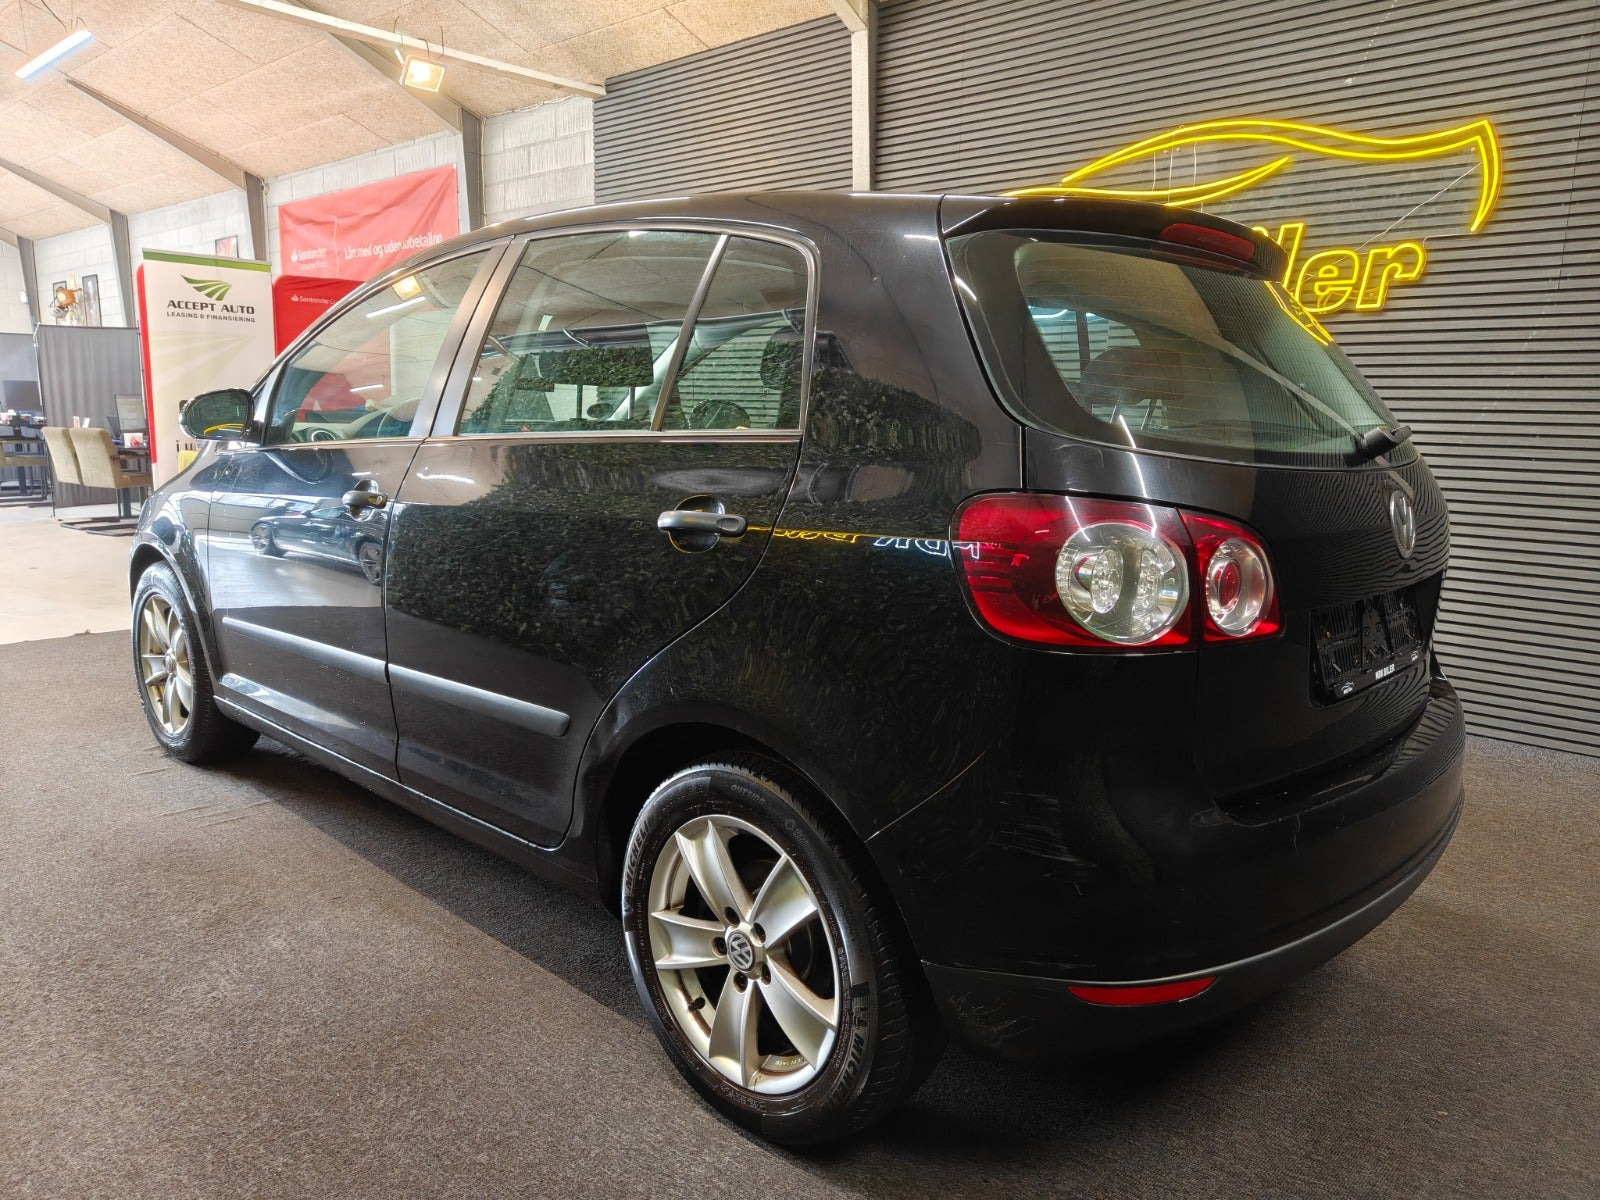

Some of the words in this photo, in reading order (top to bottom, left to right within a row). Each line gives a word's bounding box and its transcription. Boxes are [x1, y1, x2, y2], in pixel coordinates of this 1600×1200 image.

[373, 244, 384, 258] og
[299, 296, 329, 305] Santander
[167, 300, 216, 312] ACCEPT
[220, 304, 255, 315] AUTO
[166, 311, 198, 319] LEASING
[206, 314, 256, 323] FINANSIERING
